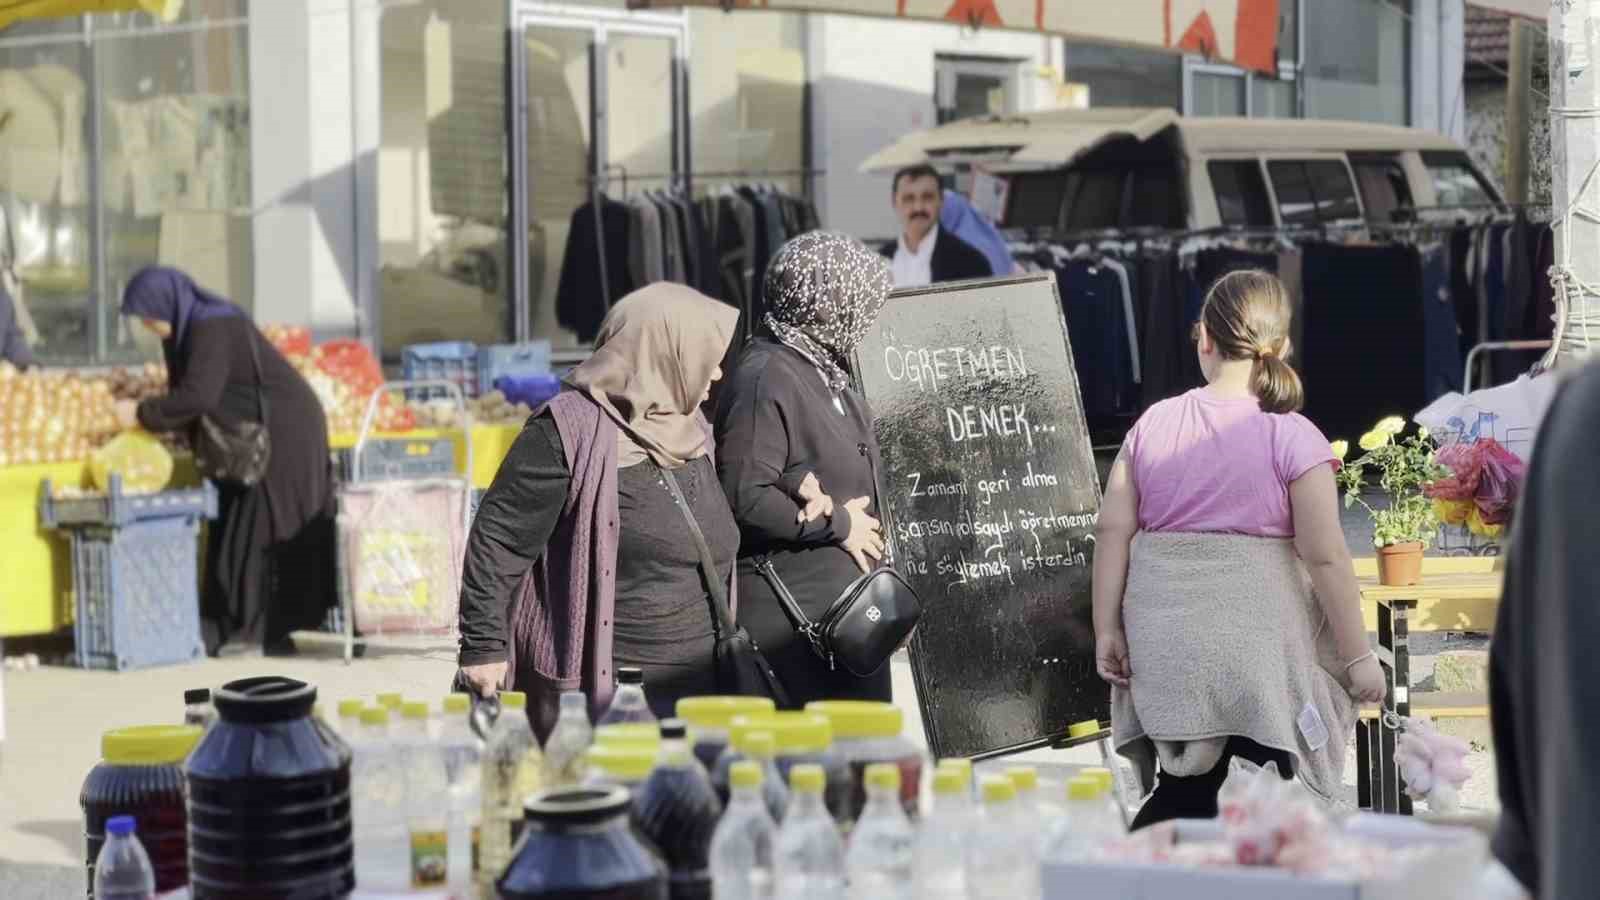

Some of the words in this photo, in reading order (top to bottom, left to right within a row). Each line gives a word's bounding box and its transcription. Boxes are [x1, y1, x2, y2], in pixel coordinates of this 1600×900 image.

[883, 328, 1027, 392] ÖĞRETMEN
[946, 403, 1056, 449] DEMEK...
[977, 468, 1010, 505] geri
[1021, 462, 1058, 488] alma
[905, 556, 928, 576] ne
[936, 550, 1016, 596] söylemek
